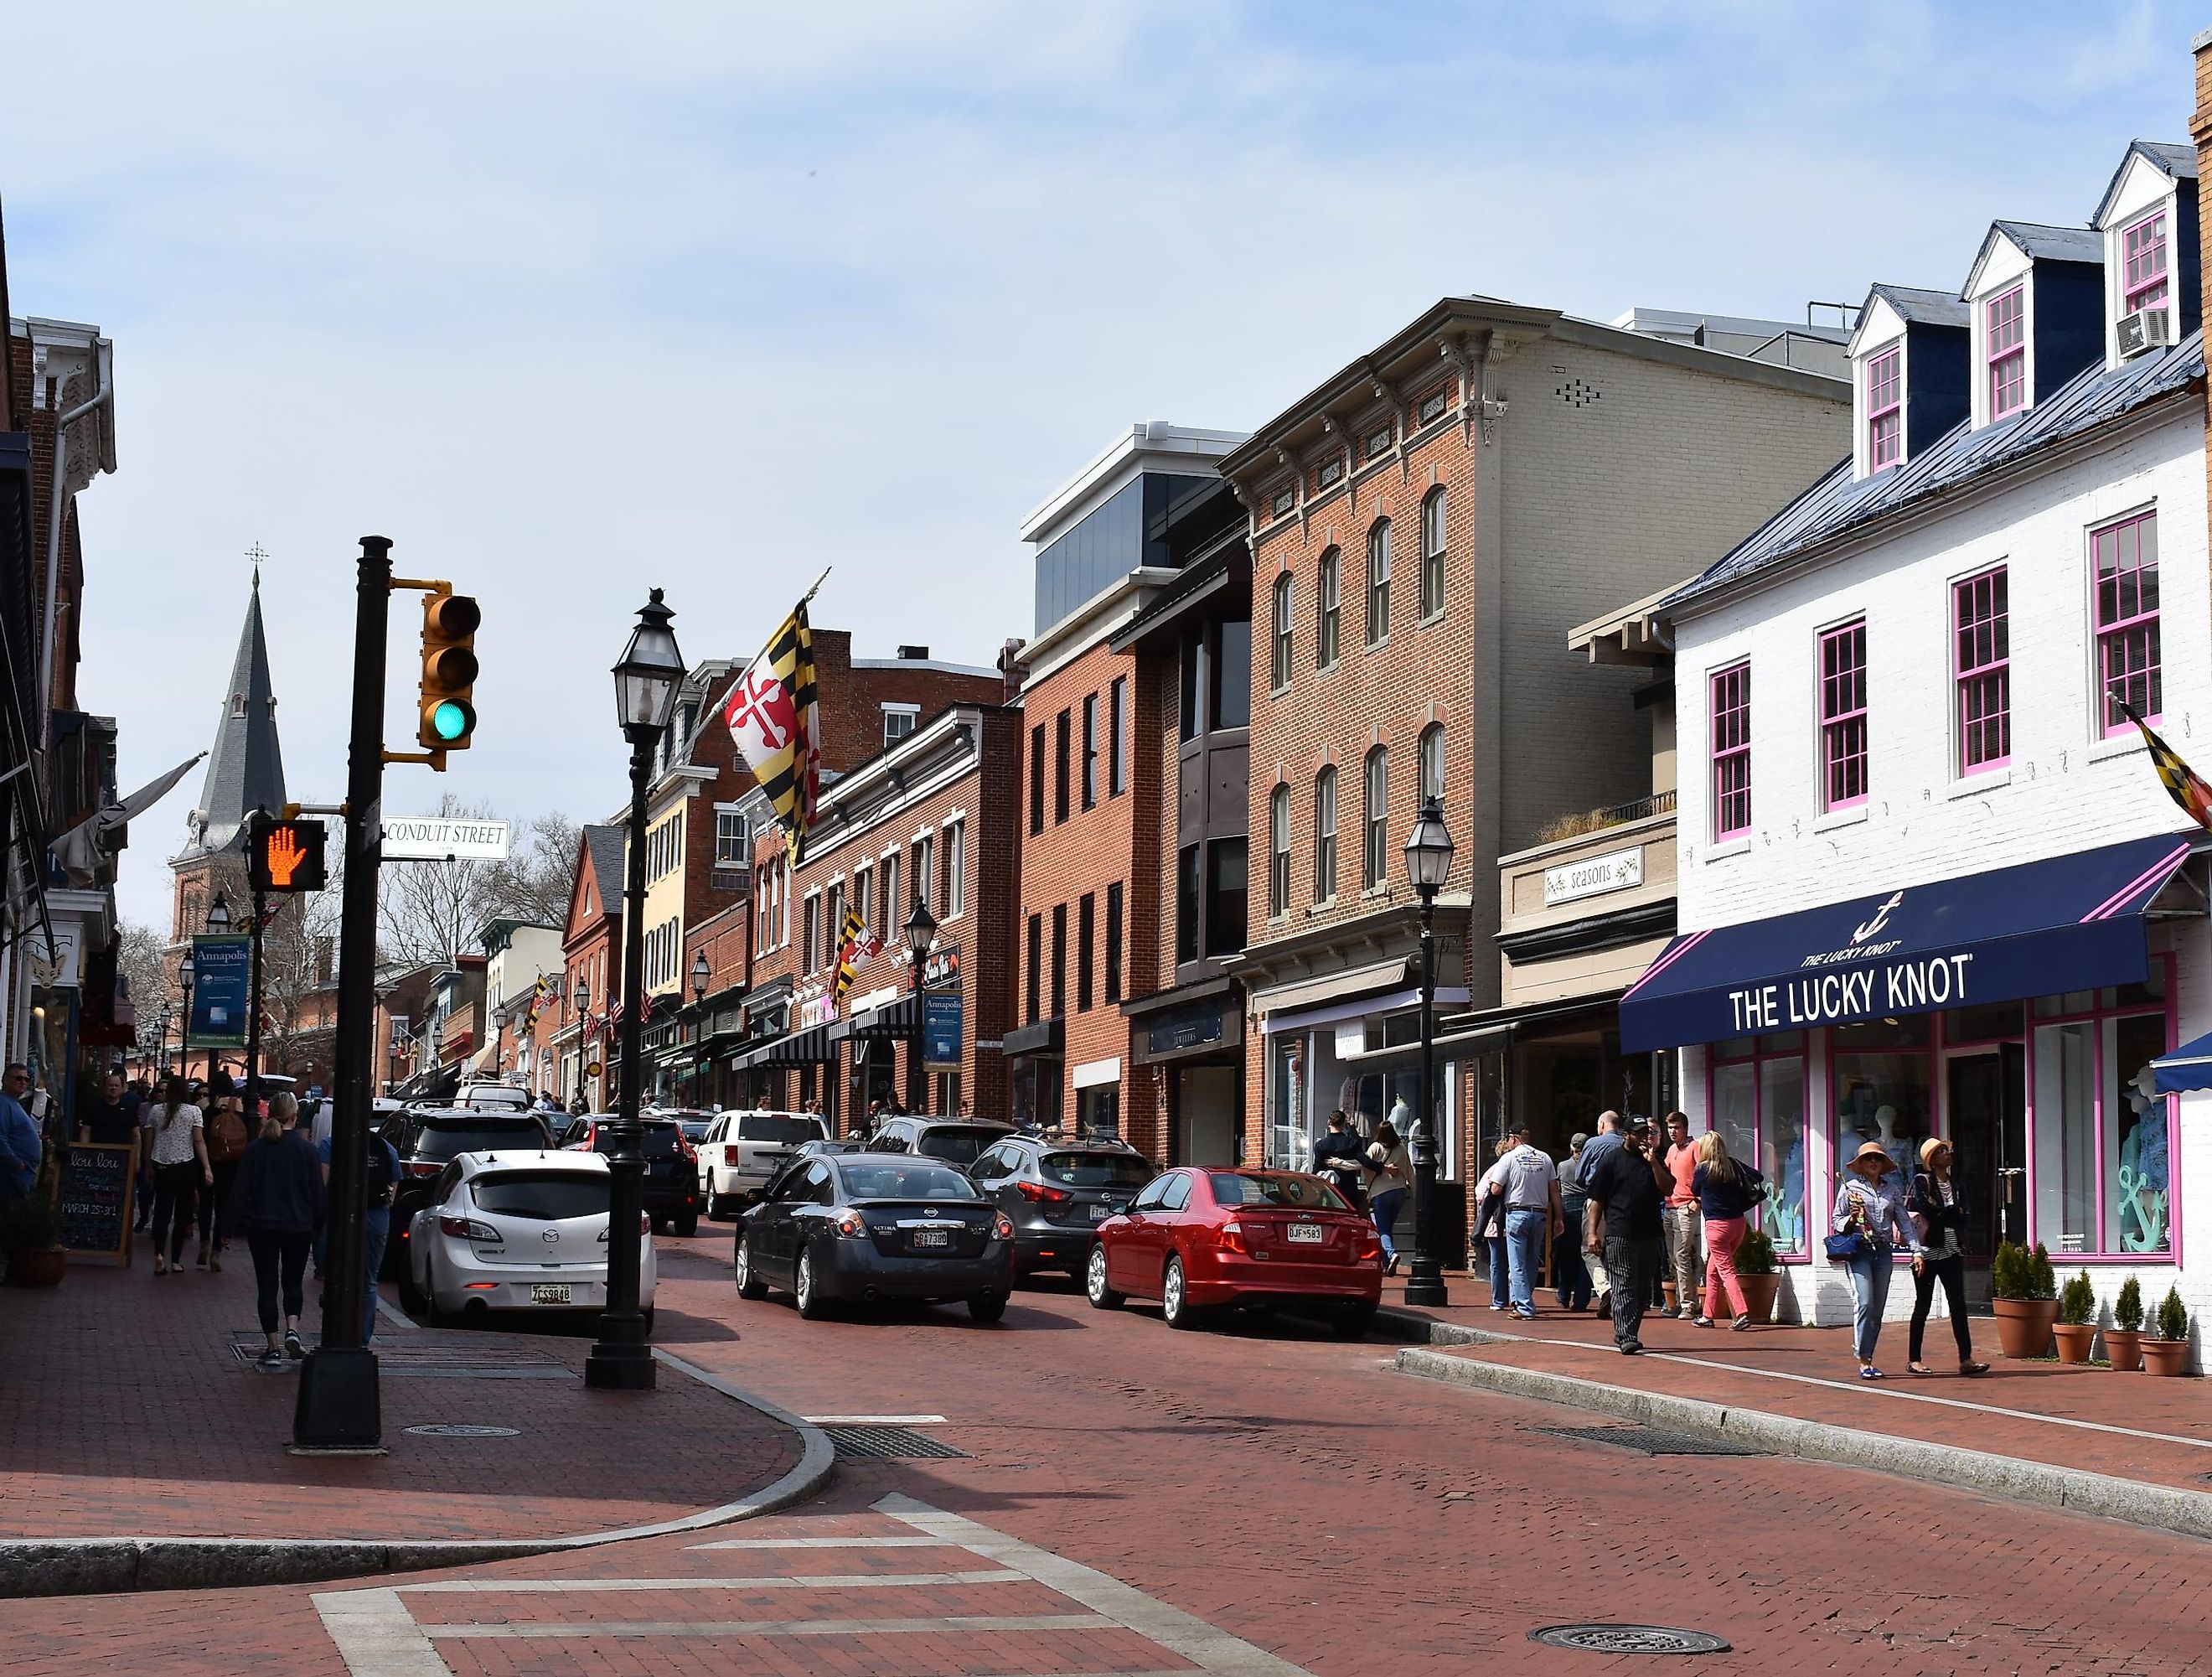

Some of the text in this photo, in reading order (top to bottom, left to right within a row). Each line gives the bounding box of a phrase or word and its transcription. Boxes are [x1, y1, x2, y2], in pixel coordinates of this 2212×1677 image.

[387, 823, 504, 844] CONDUIT STREET
[1571, 864, 1611, 889] seasons
[197, 950, 247, 963] Annapolis
[1800, 954, 1827, 968] THE
[1822, 946, 1865, 964] LUCKY
[1729, 954, 1969, 1031] THE LUCKY KNOT
[926, 1000, 962, 1011] Annapolis
[70, 1152, 119, 1168] lou lou
